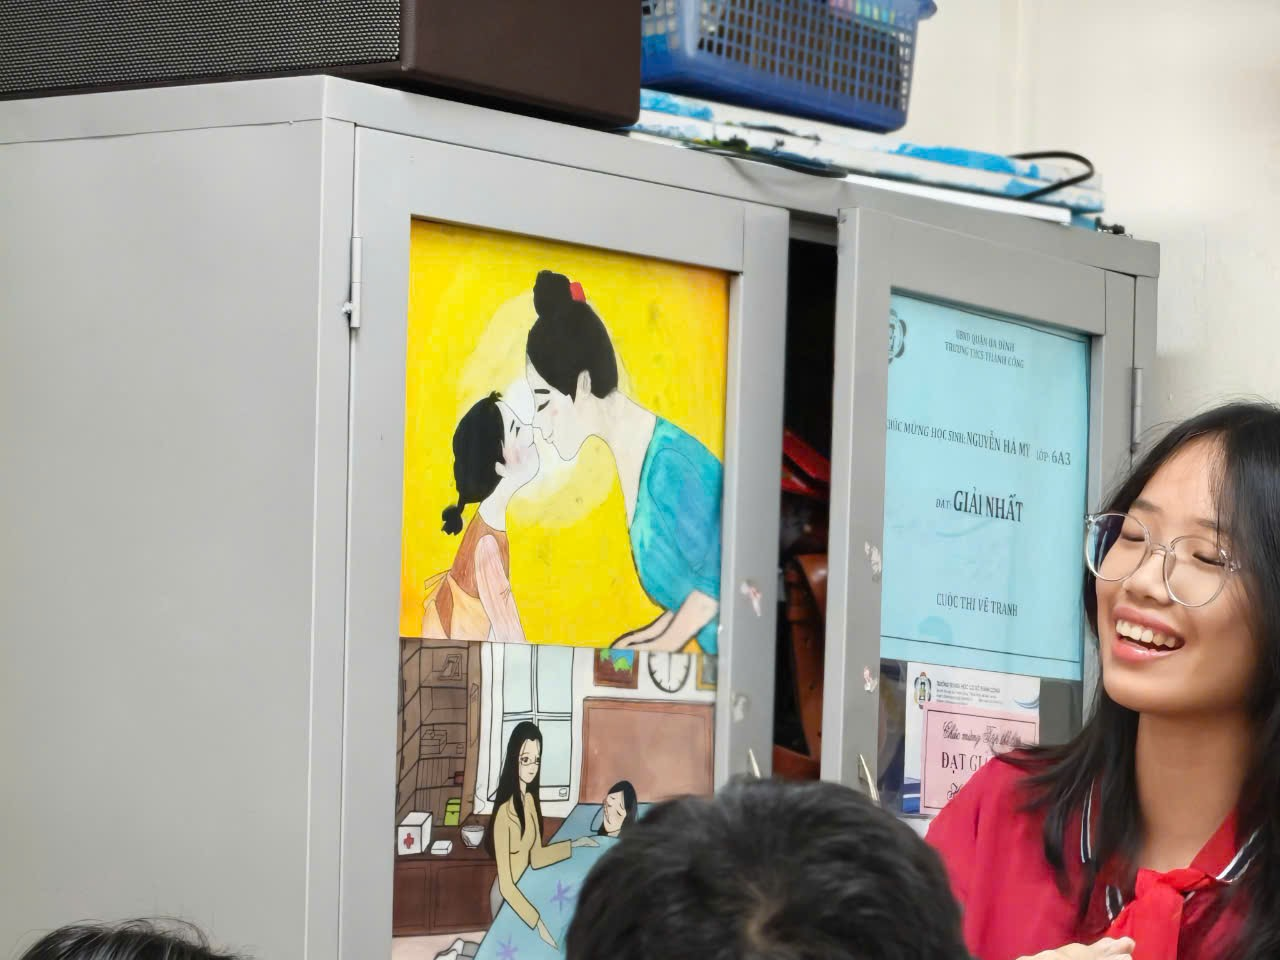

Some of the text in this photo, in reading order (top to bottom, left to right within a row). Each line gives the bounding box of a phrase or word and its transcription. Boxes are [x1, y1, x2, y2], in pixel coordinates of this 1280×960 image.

[1051, 450, 1071, 466] 6A3
[953, 486, 982, 515] GIẢI
[986, 493, 1024, 523] NHẤT
[936, 592, 959, 611] CUỘC
[960, 596, 976, 611] THI
[990, 600, 1018, 617] TRANH
[941, 751, 967, 774] ĐẠT
